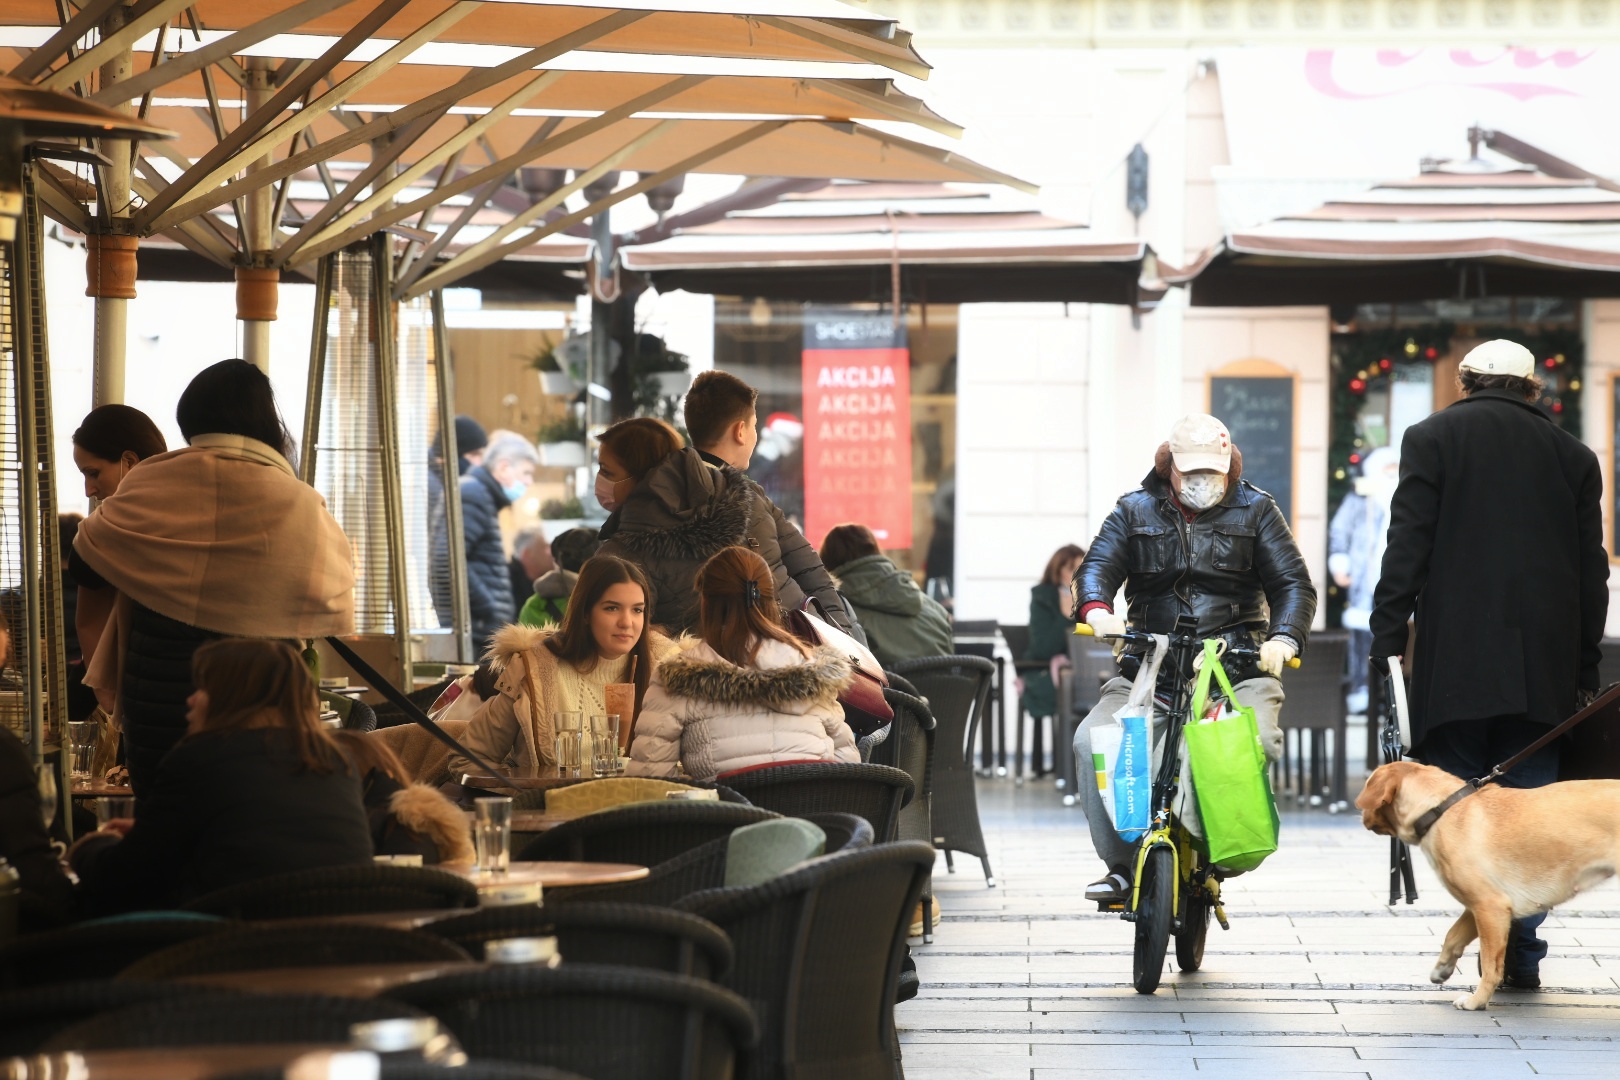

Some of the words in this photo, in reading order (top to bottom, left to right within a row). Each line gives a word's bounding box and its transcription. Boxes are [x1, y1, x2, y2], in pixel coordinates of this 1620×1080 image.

[817, 366, 895, 387] AKCIJA
[818, 394, 896, 414] AKCIJA
[818, 421, 896, 441] AKCIJA
[819, 448, 897, 468] AKCIJA
[820, 475, 896, 495] AKCIJA
[1125, 733, 1136, 814] microsoft.com
